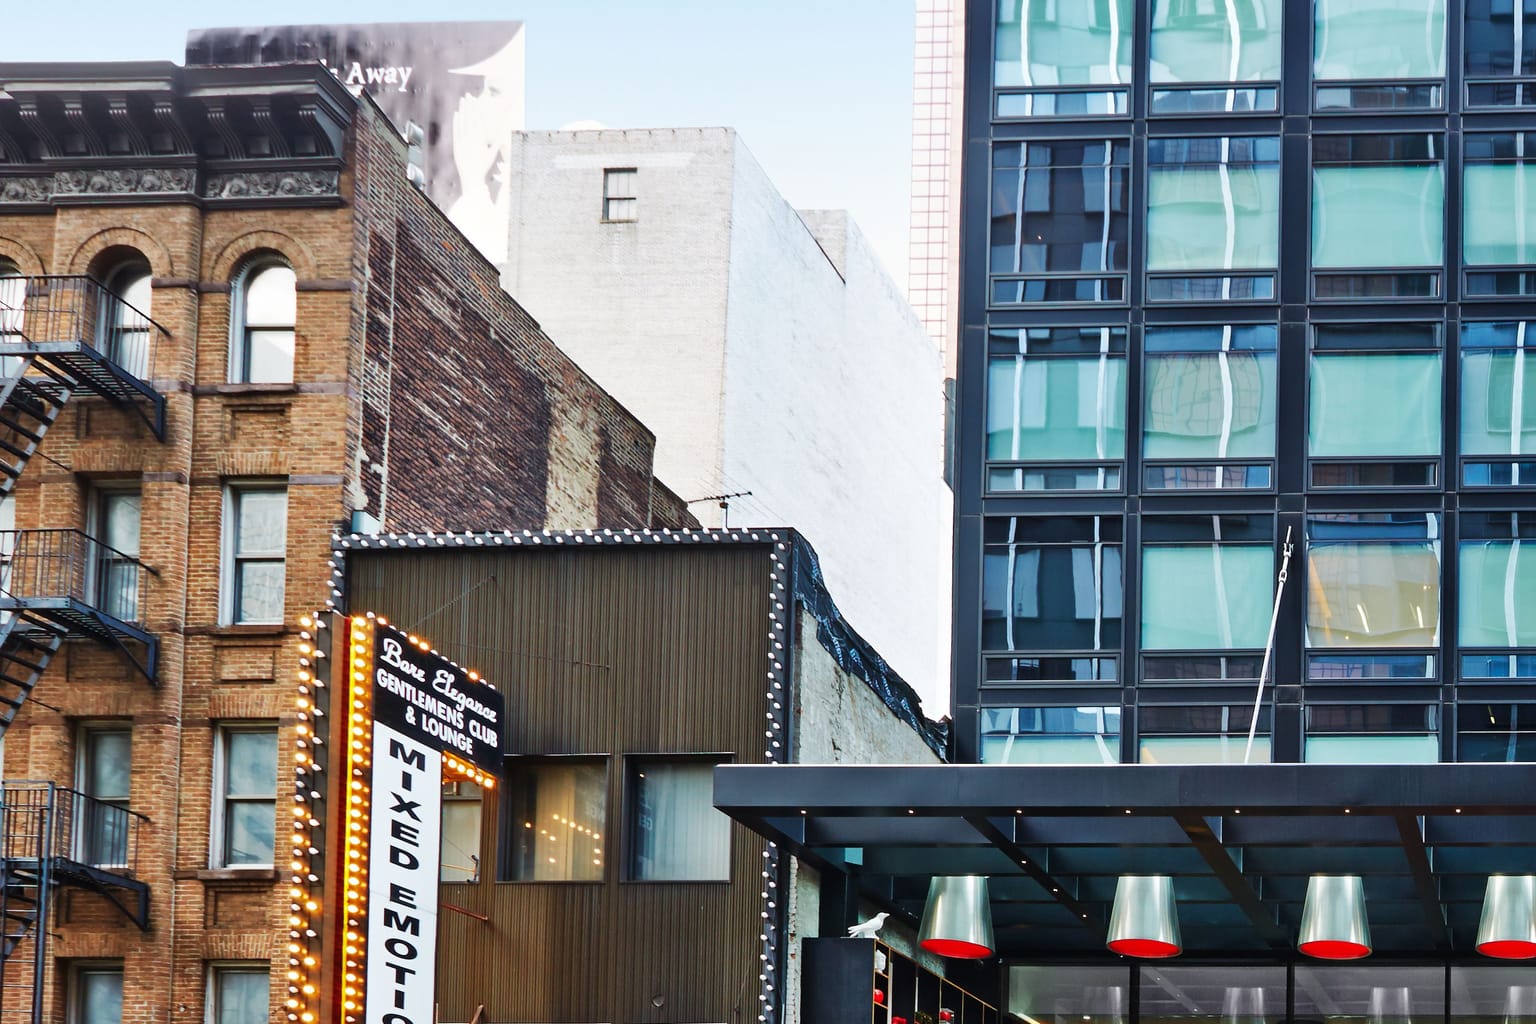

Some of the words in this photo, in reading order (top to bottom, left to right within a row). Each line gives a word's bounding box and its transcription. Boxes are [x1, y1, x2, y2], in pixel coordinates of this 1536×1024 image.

[345, 61, 413, 92] Away
[376, 668, 464, 730] GENTLEMENS
[468, 719, 498, 748] CLUB
[380, 638, 426, 682] Bare
[432, 669, 498, 723] Elegance
[405, 705, 417, 726] &
[421, 713, 473, 755] LOUNGE
[388, 738, 426, 870] MIXED
